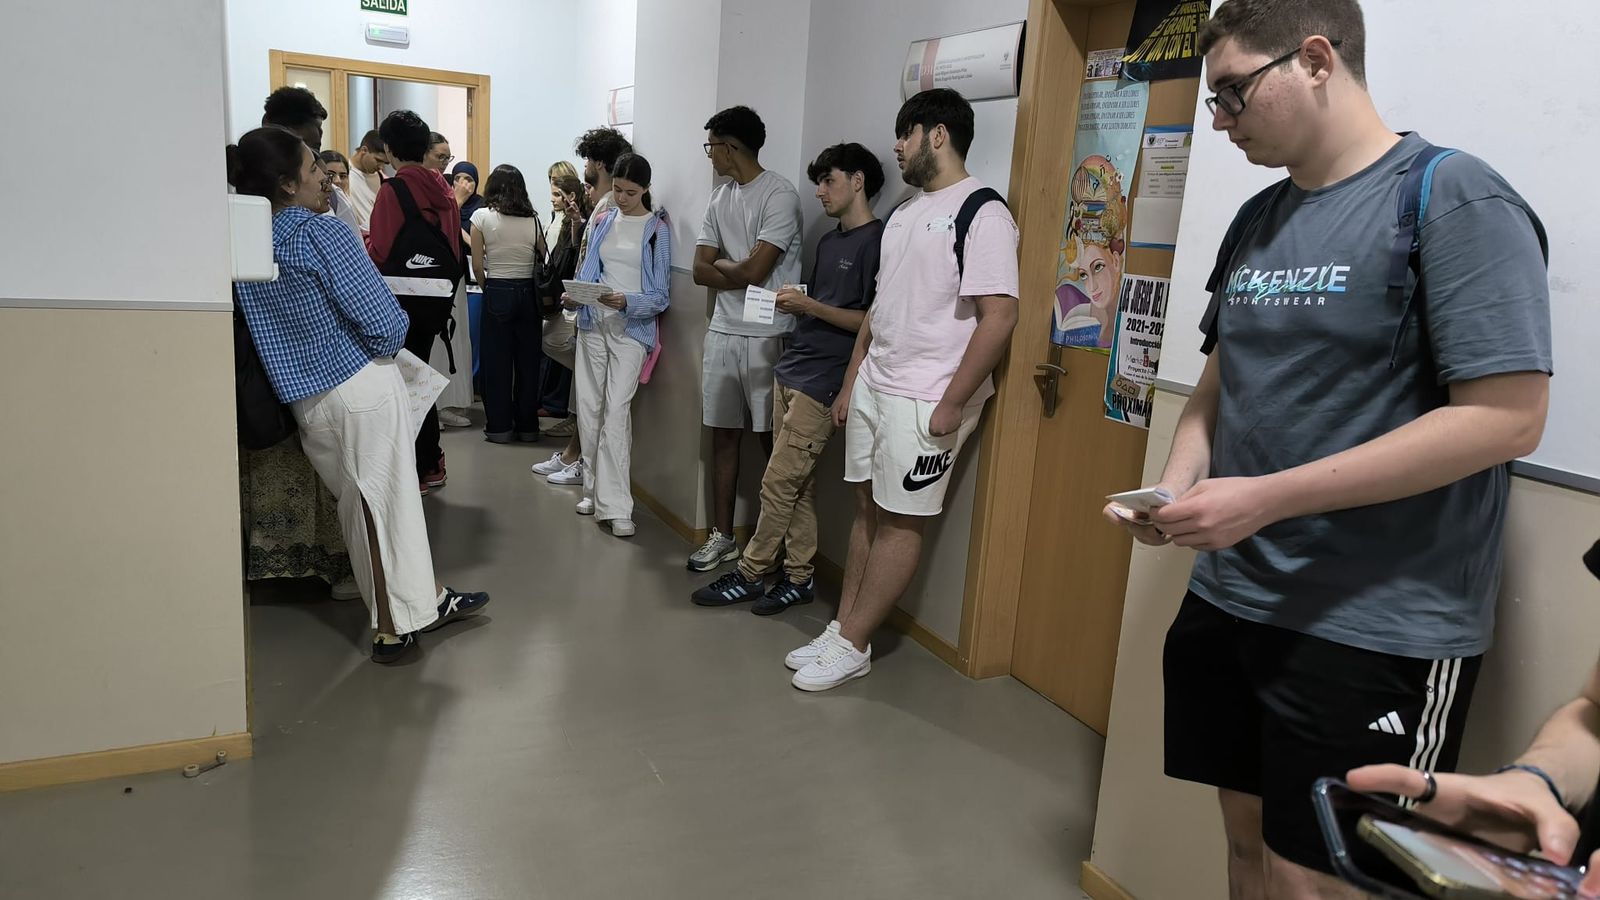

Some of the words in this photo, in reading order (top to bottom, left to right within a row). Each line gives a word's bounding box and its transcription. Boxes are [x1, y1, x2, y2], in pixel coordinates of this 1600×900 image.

[361, 0, 406, 12] SALIDA
[411, 253, 435, 266] NIKE
[1228, 296, 1326, 307] SPORTSWEAR
[1130, 336, 1162, 350] Introducció
[912, 448, 952, 476] NIKE
